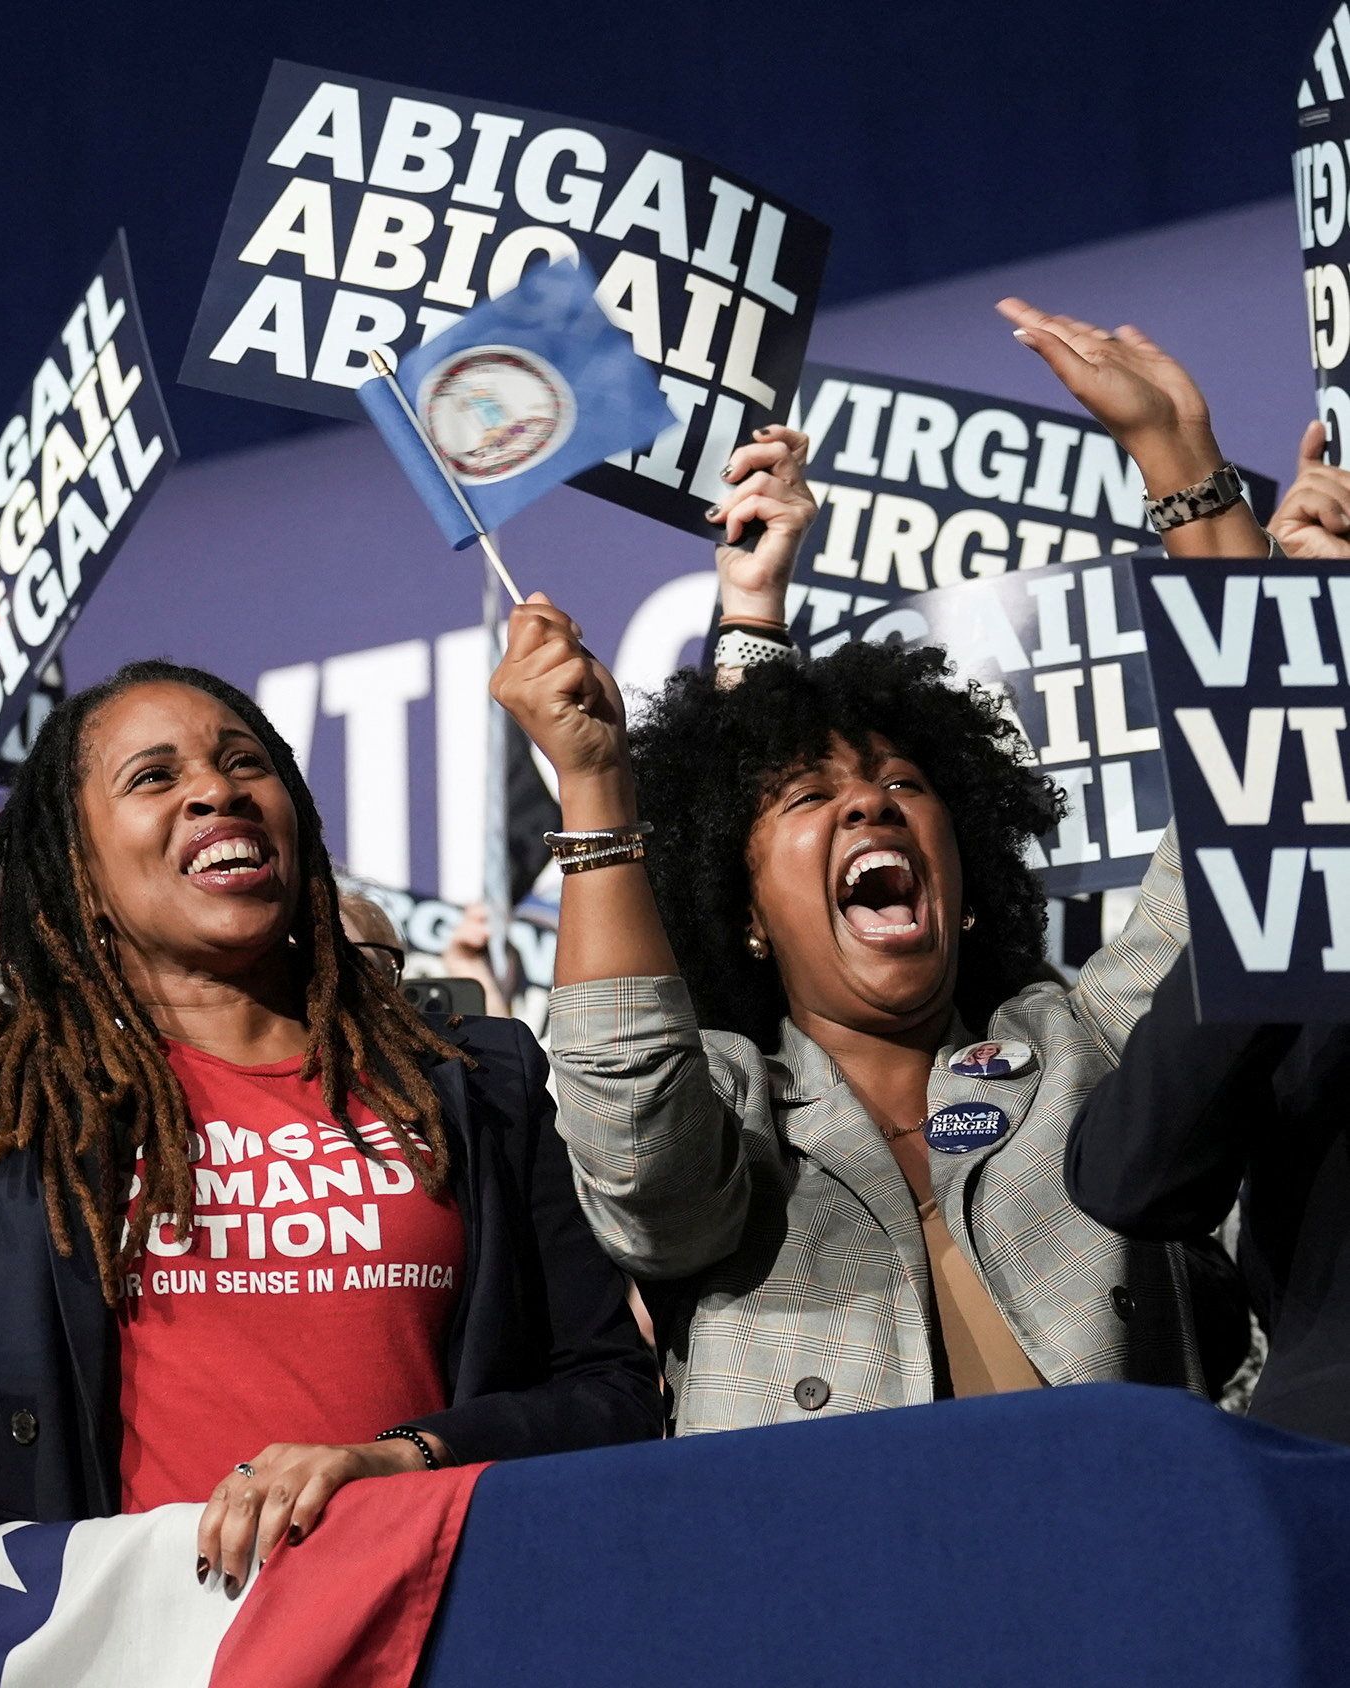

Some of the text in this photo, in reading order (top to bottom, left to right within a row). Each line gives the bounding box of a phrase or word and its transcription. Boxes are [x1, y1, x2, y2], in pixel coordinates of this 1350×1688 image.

[266, 82, 798, 315] ABIGAIL
[786, 379, 1153, 533] VIRGIN
[931, 1120, 998, 1133] BERGER
[932, 1112, 975, 1124] SPAN
[947, 1129, 998, 1137] GOVERNOR
[129, 1160, 414, 1208] MAND
[153, 1270, 206, 1295] GUN
[216, 1269, 299, 1294] SENSE
[308, 1268, 333, 1292] IN
[344, 1264, 452, 1290] AMERICA
